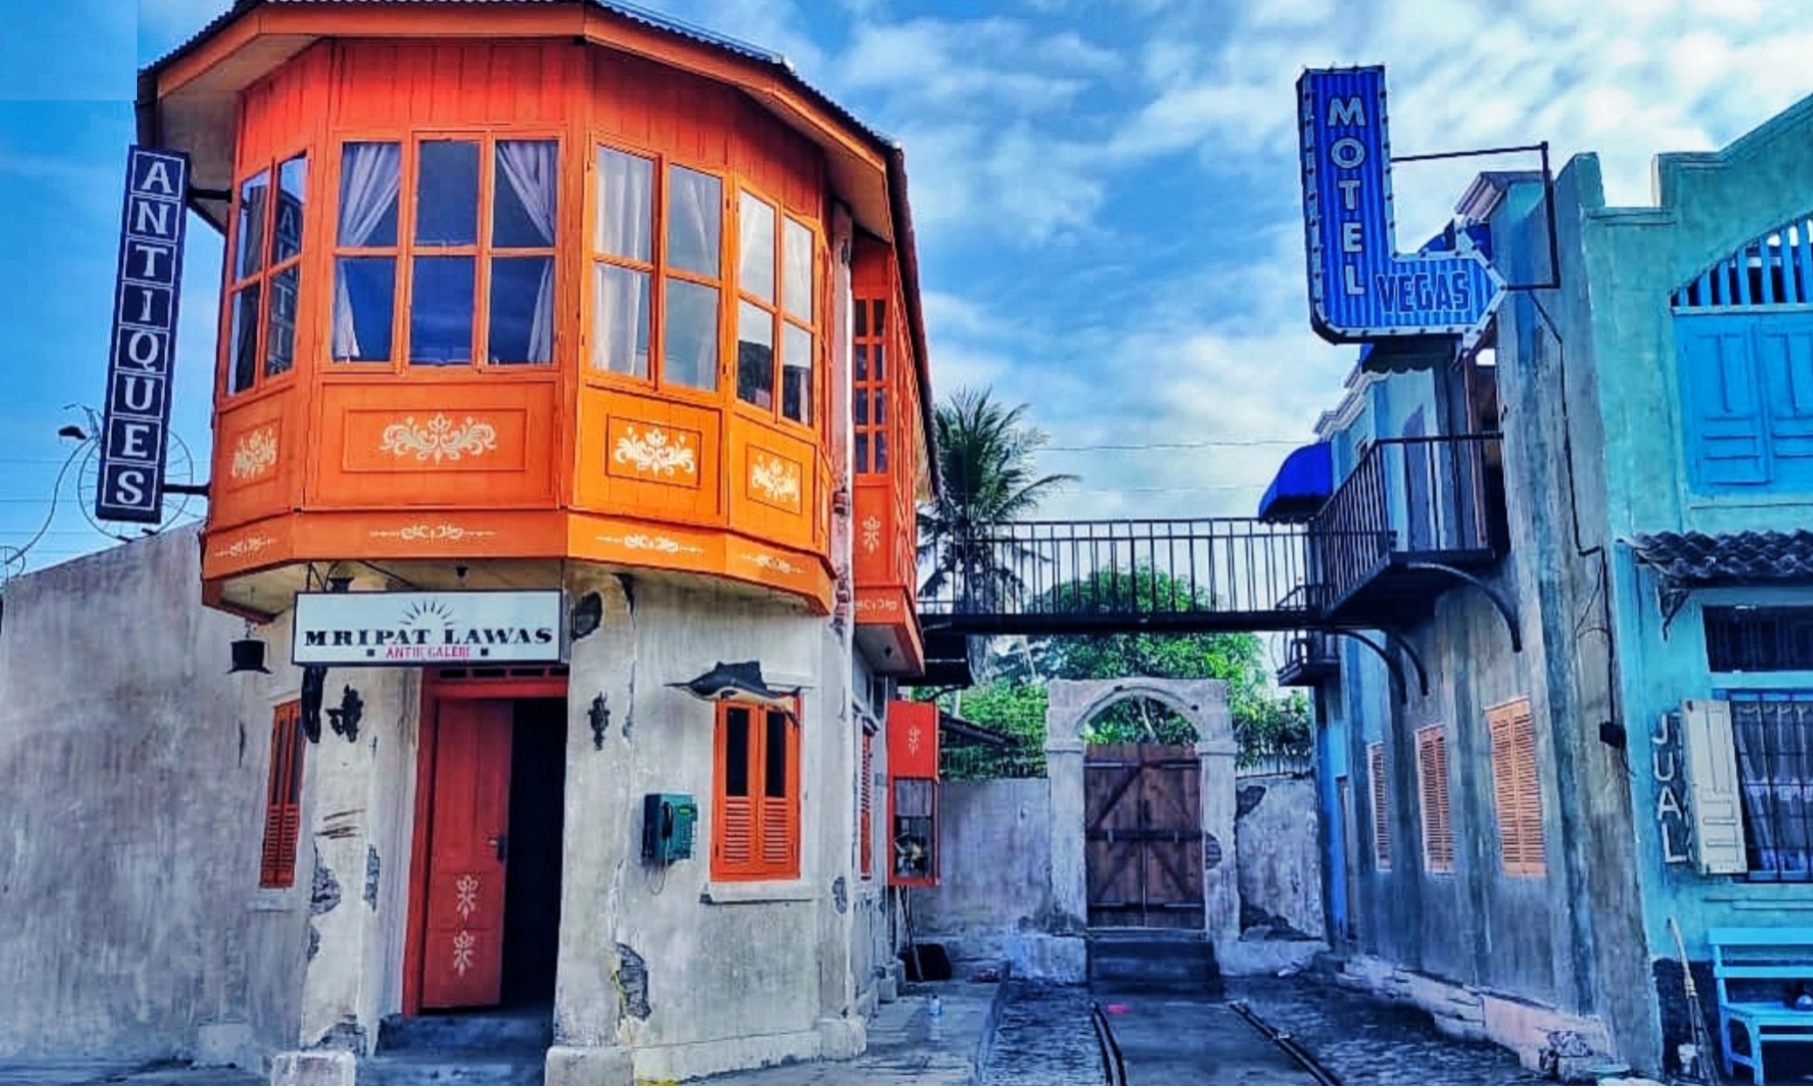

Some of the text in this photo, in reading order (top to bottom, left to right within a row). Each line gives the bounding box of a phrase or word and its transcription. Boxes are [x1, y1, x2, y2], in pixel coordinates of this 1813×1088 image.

[1327, 97, 1366, 296] MOTEL
[116, 161, 174, 505] ANTIQUES
[1375, 271, 1471, 314] VEGAS
[304, 627, 553, 646] MRIPAT LAWAS
[1652, 713, 1688, 863] JUAL
